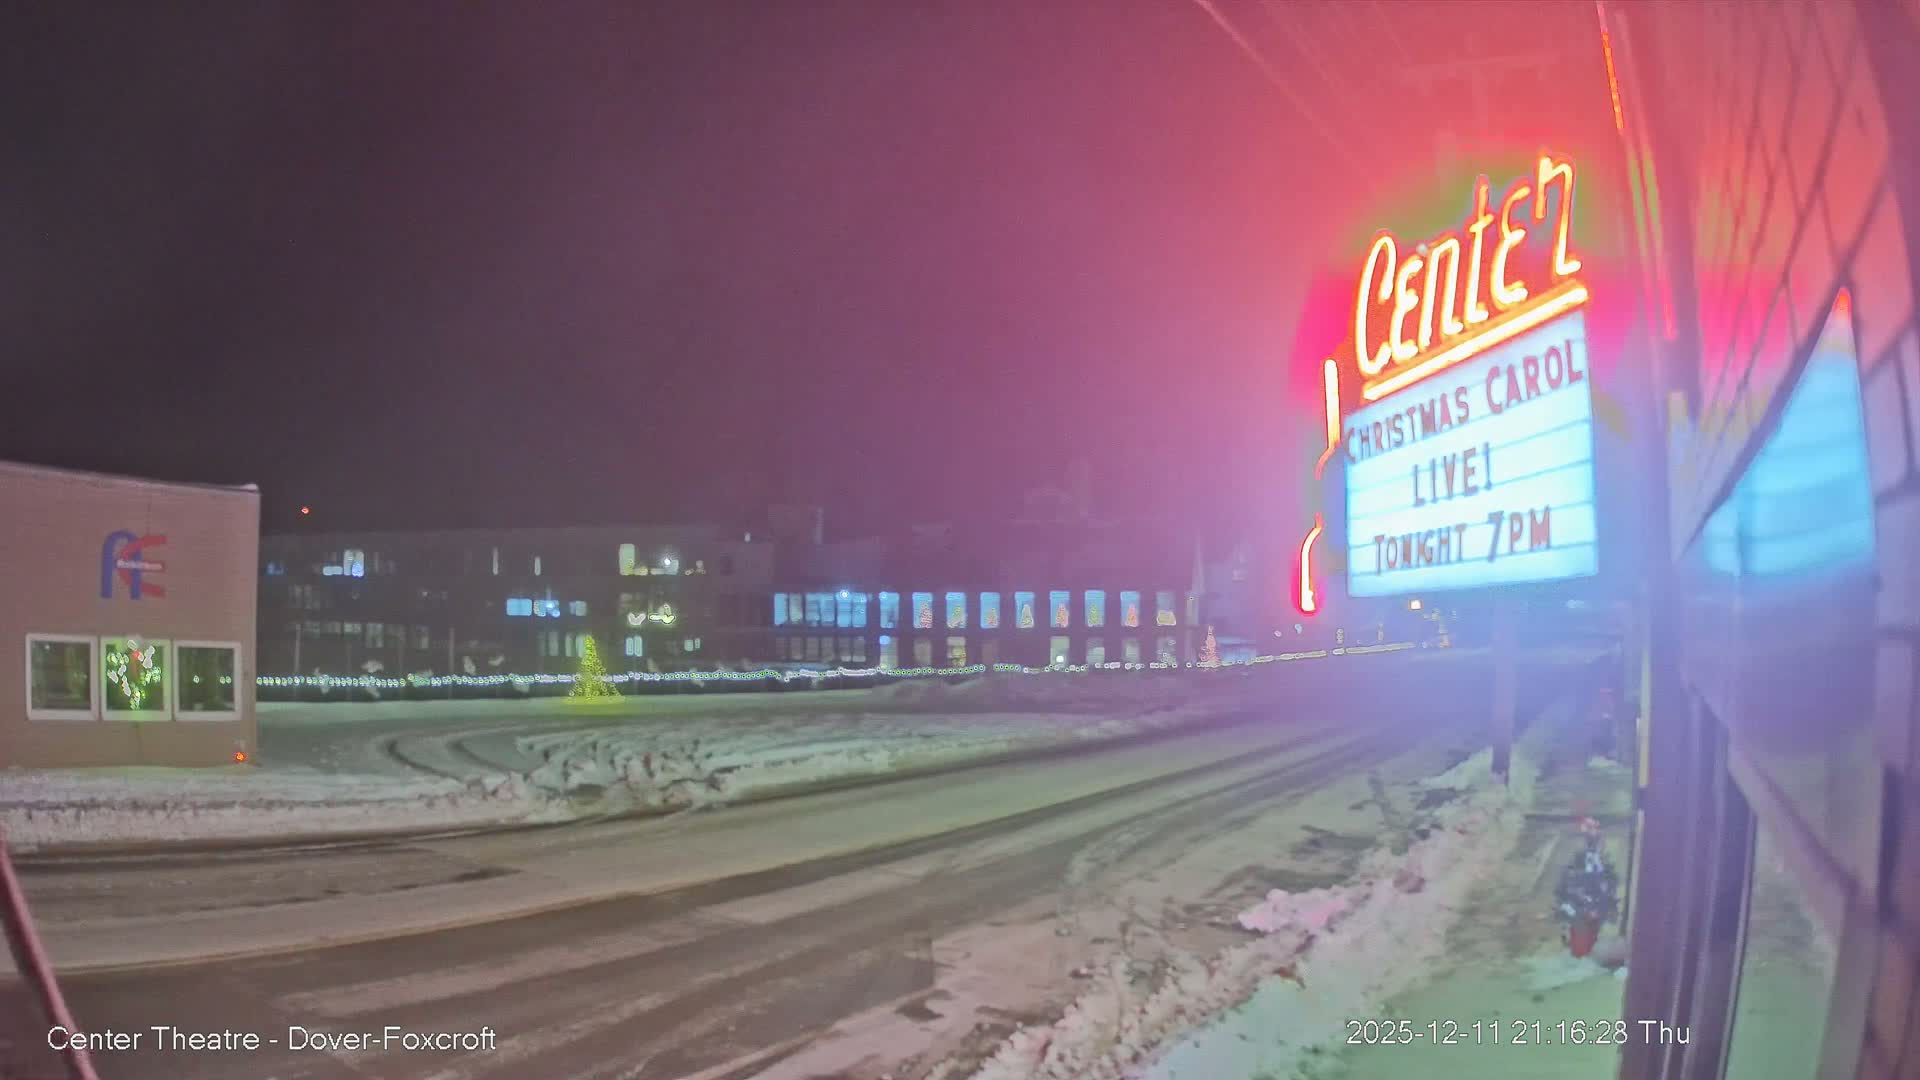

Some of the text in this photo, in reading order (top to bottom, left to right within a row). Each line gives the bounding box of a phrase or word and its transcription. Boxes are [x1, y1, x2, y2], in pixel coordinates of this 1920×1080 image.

[1355, 155, 1582, 376] Center
[1346, 339, 1584, 463] CHRISTMAS CAROL
[1413, 441, 1493, 508] LIVE!
[1374, 522, 1468, 576] TONIGHT
